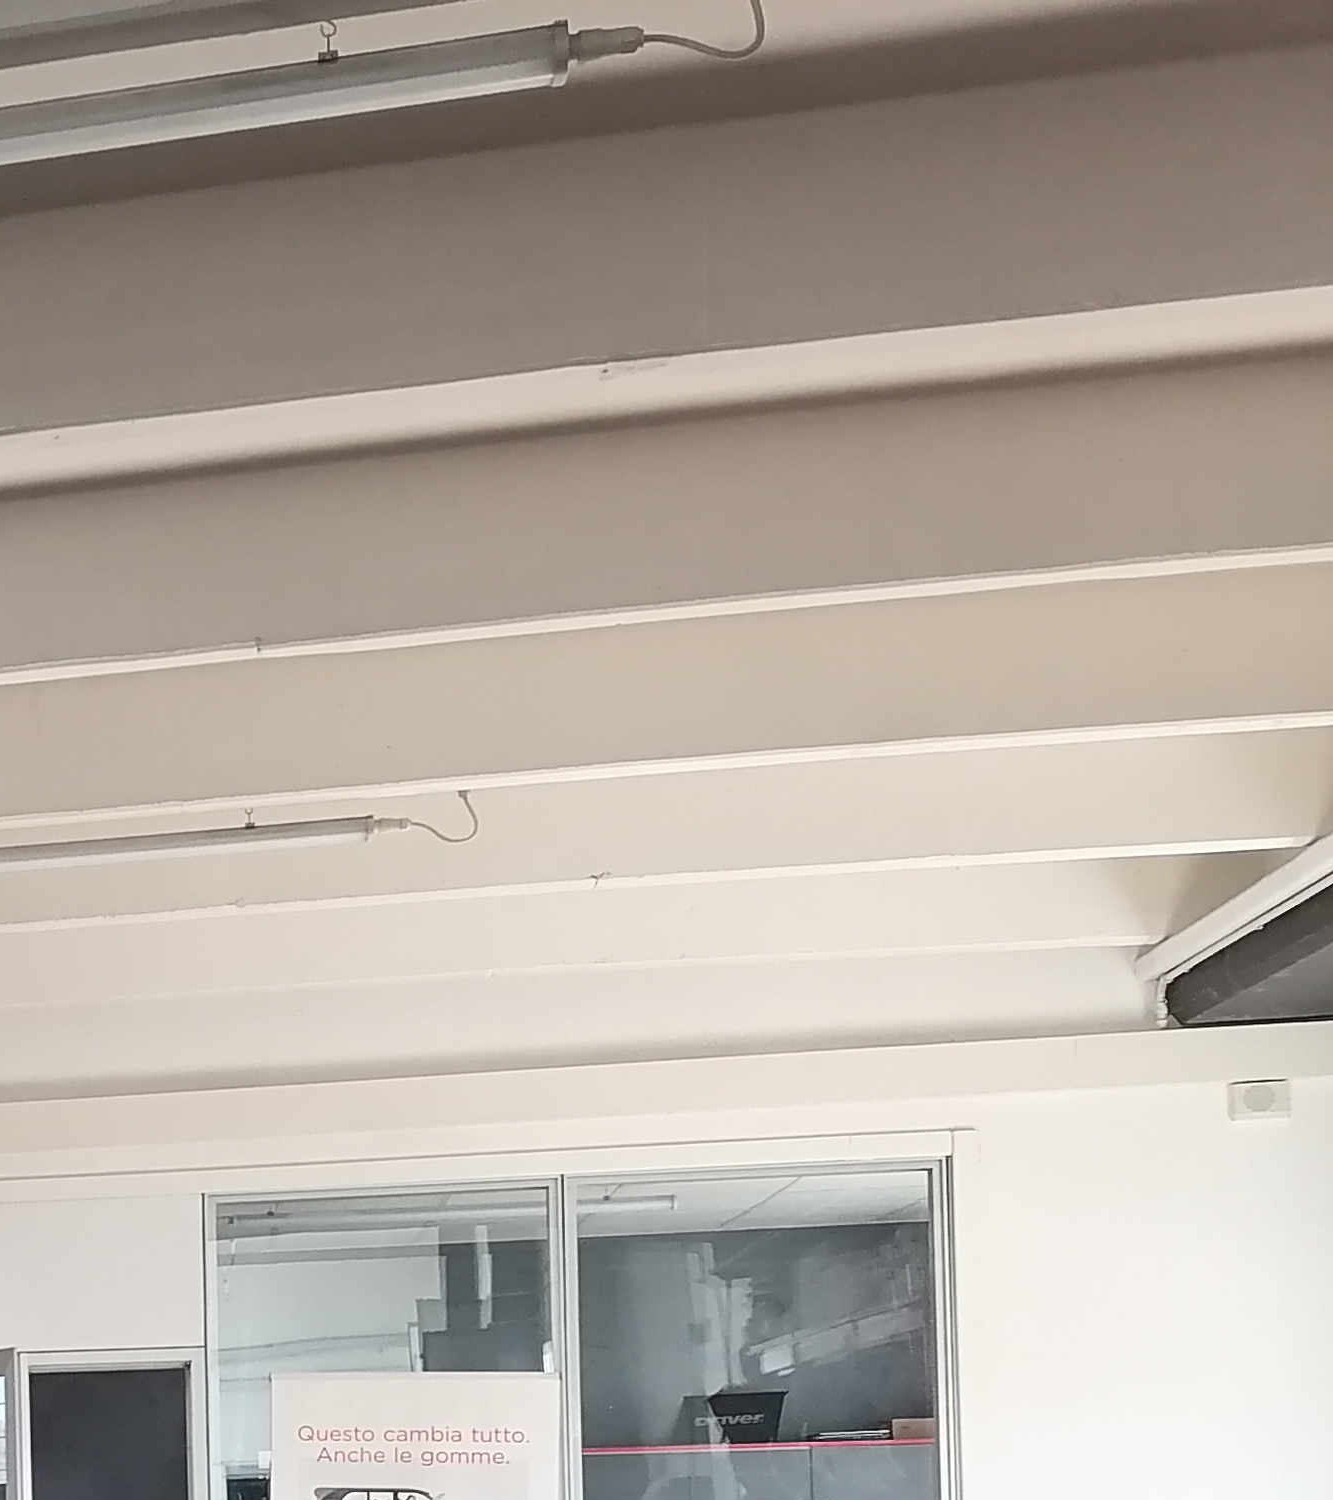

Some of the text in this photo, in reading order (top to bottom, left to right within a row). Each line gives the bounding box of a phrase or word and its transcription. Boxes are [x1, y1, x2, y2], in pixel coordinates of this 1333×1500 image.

[298, 1426, 531, 1443] Questo cambia tutto.
[317, 1447, 511, 1467] Anche le gomme.
